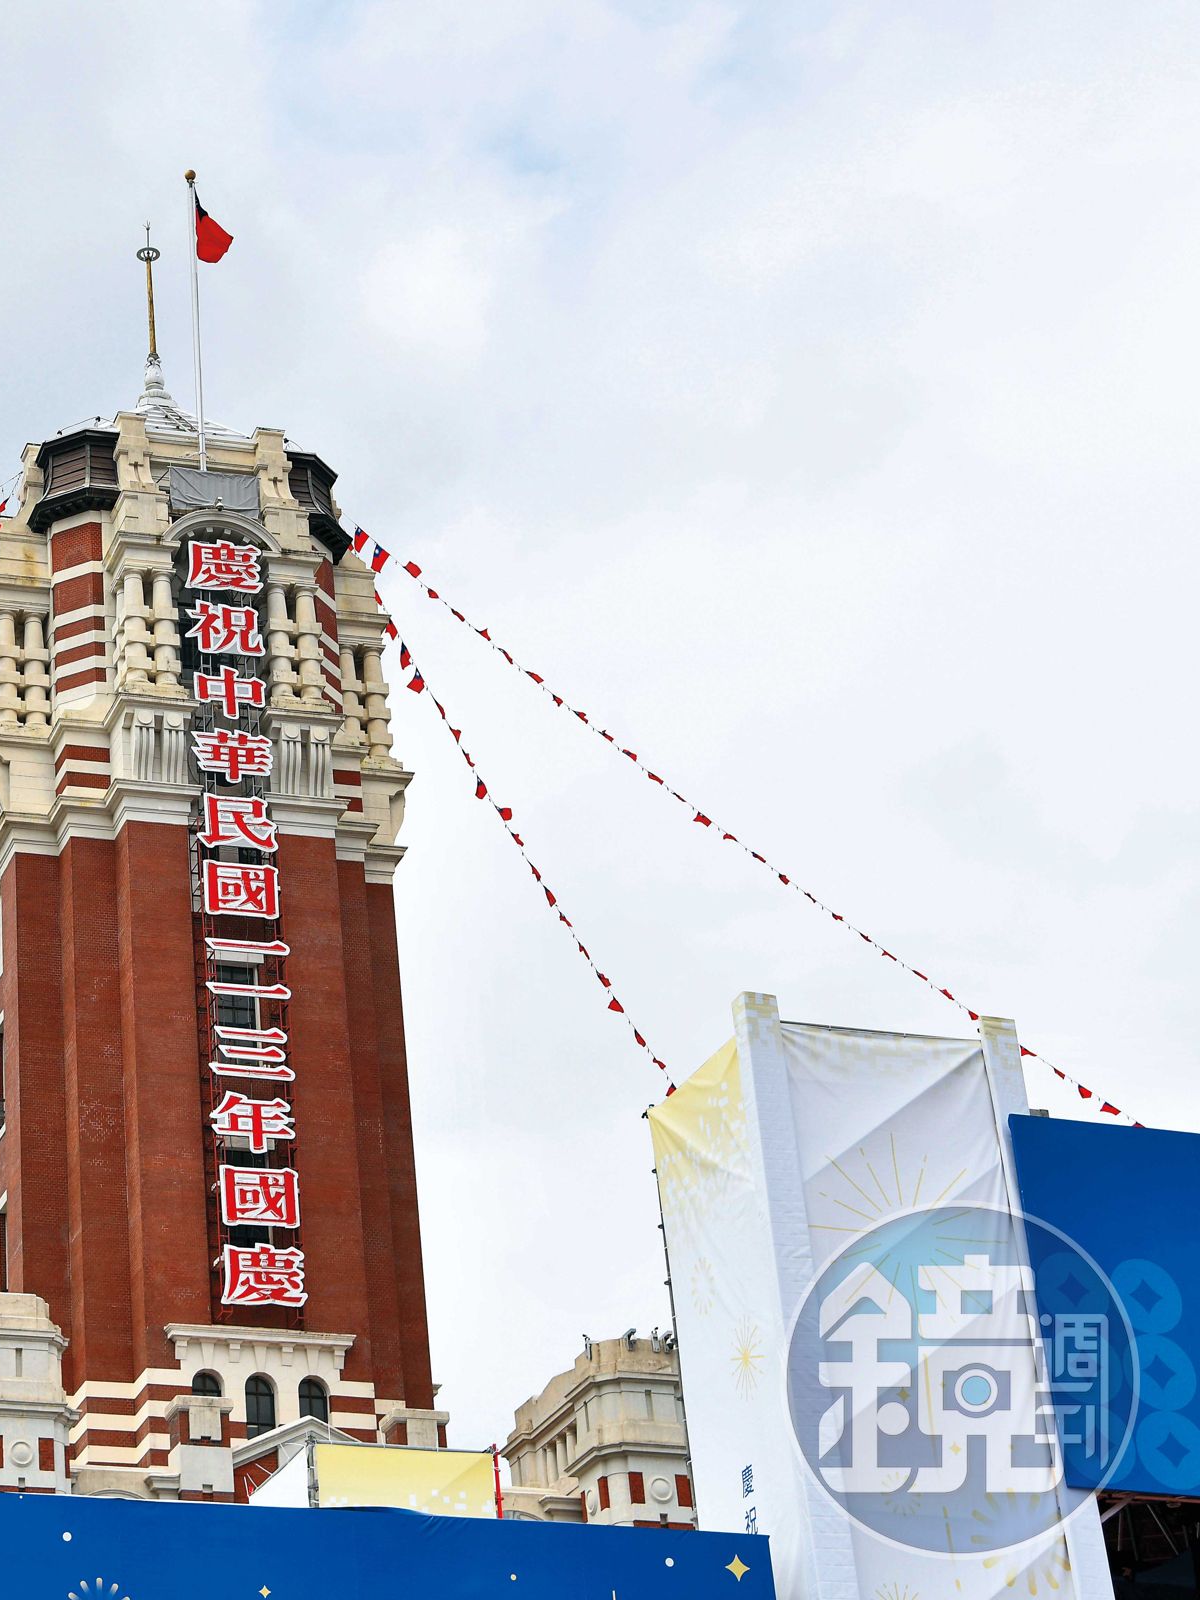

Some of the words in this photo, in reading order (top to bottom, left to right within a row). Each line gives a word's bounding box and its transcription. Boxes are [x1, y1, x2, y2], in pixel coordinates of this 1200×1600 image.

[185, 540, 308, 1307] 慶祝中華民國一一三年國慶
[742, 1464, 759, 1534] 慶祝
